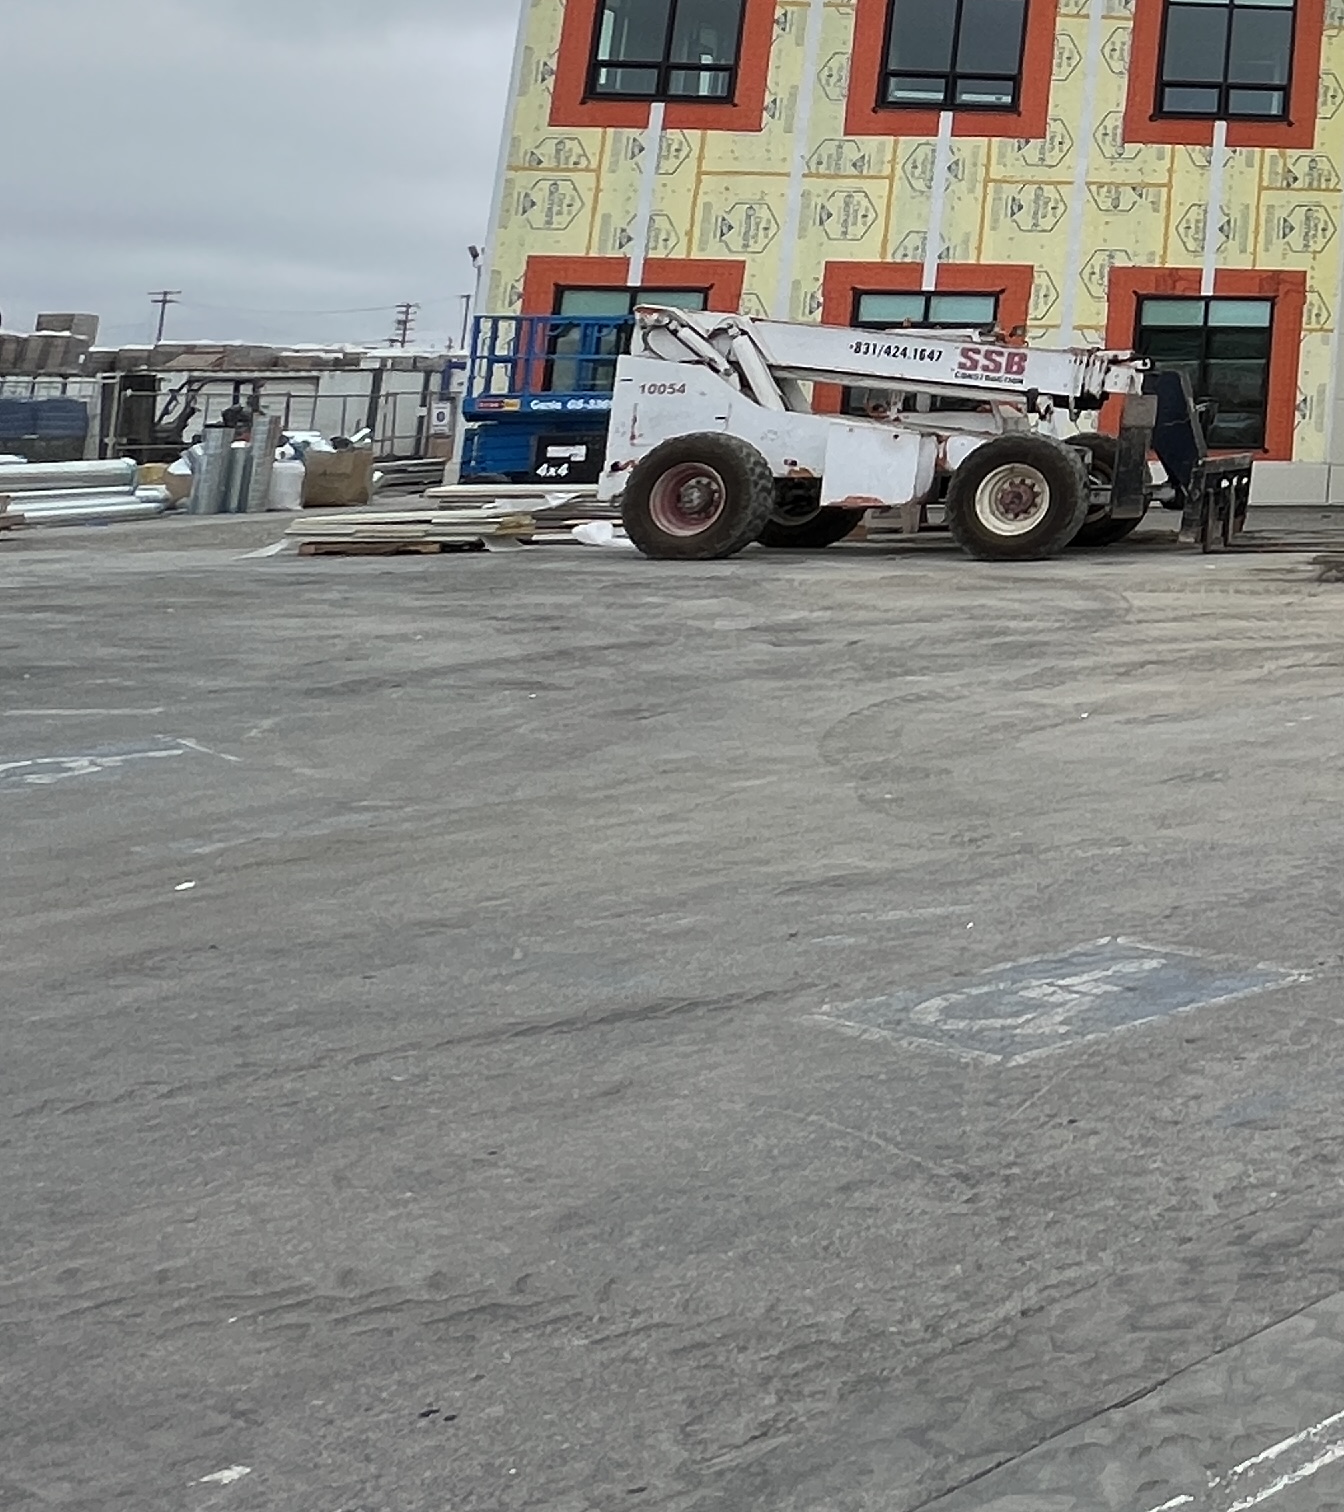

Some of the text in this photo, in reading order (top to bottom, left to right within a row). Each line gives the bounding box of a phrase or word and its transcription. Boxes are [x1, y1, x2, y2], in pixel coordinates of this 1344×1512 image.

[957, 346, 1028, 376] SSB
[639, 383, 687, 395] 10054
[536, 462, 569, 478] 4x4
